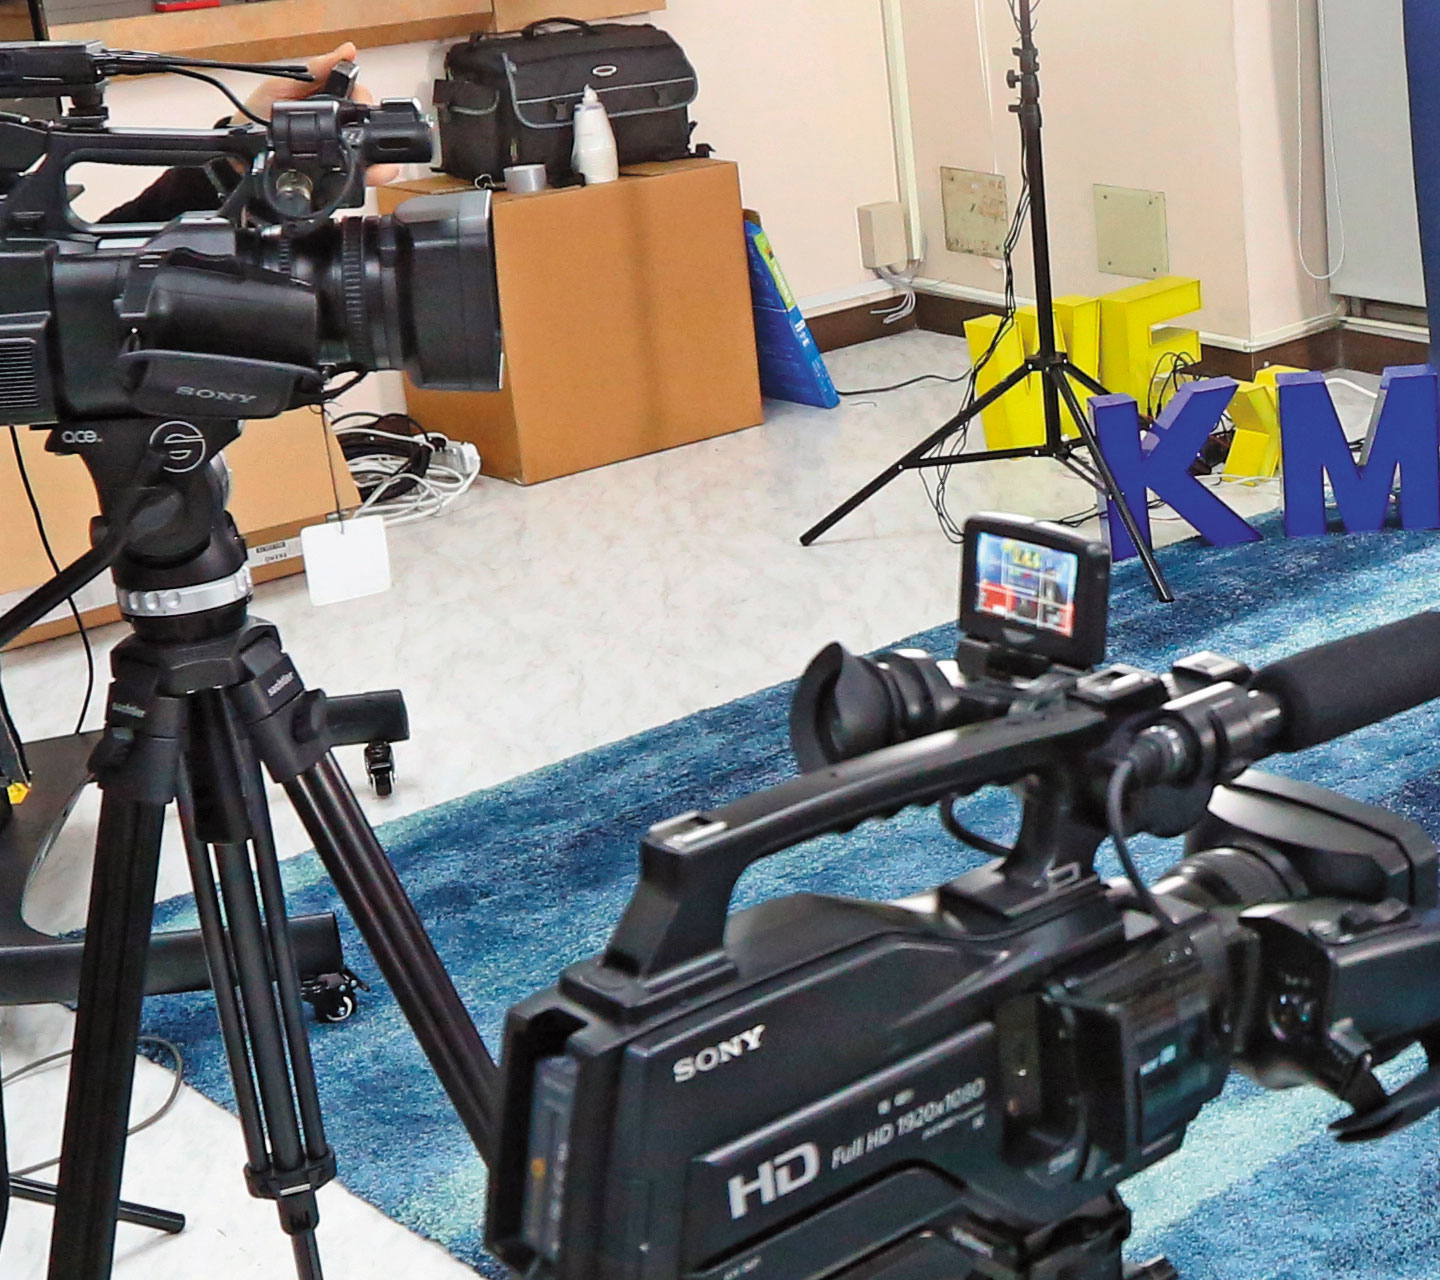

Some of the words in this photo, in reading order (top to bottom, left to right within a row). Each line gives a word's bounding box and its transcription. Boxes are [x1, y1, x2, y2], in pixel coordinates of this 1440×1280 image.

[175, 385, 259, 404] SONY
[672, 1023, 766, 1083] SONY
[727, 1140, 820, 1220] HD
